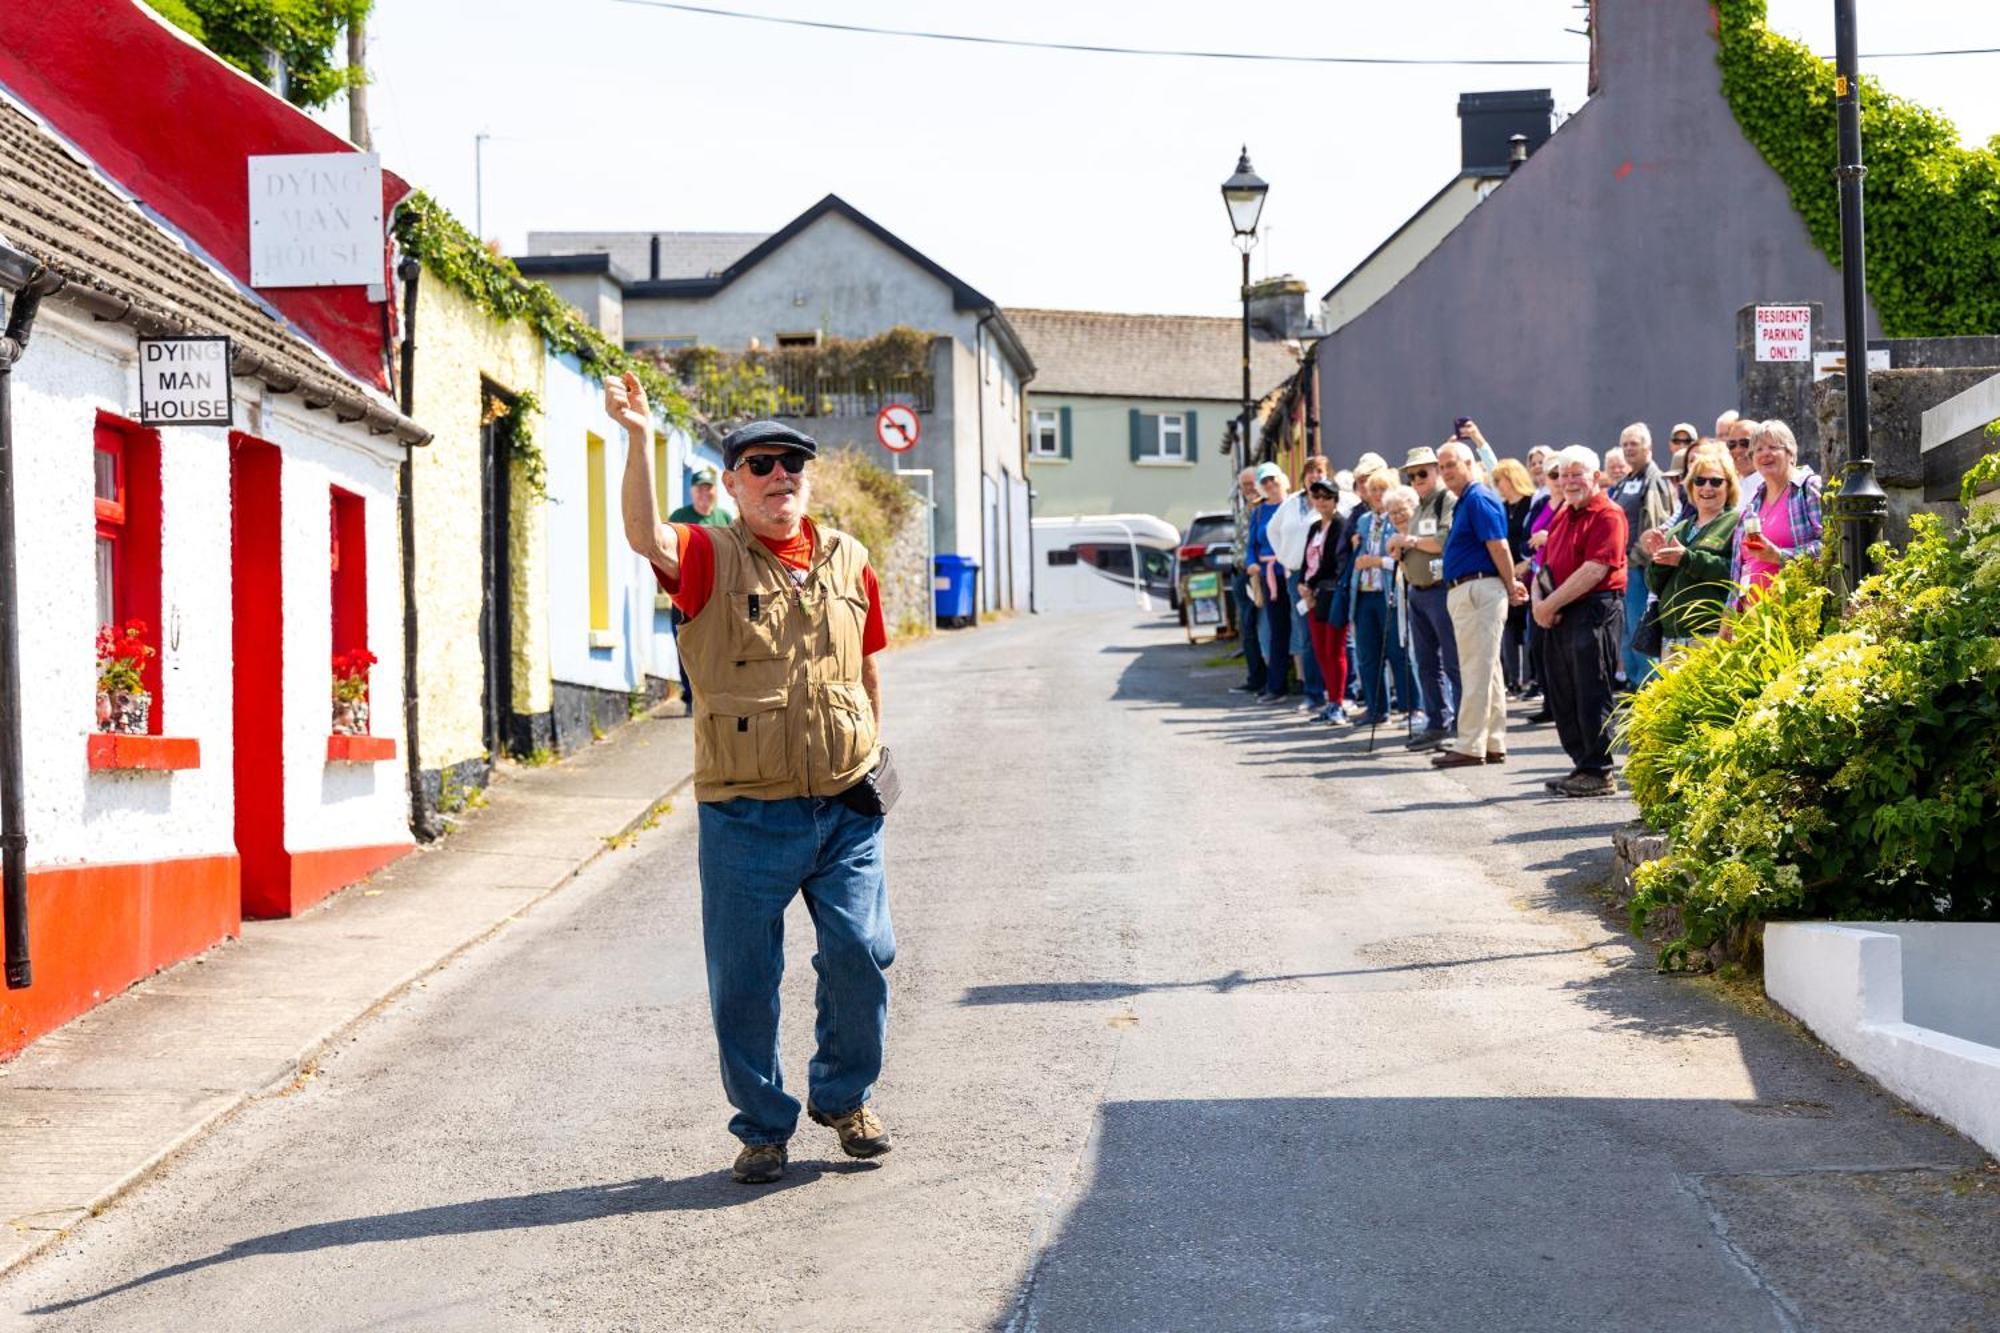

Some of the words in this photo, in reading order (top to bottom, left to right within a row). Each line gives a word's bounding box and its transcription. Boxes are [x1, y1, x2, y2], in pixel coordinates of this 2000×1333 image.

[267, 171, 361, 196] DYING
[1758, 310, 1810, 323] RESIDENTS
[1763, 328, 1804, 341] PARKING
[147, 343, 220, 362] DYING
[1770, 346, 1798, 360] ONLY!
[159, 371, 211, 390] MAN
[144, 400, 227, 418] HOUSE
